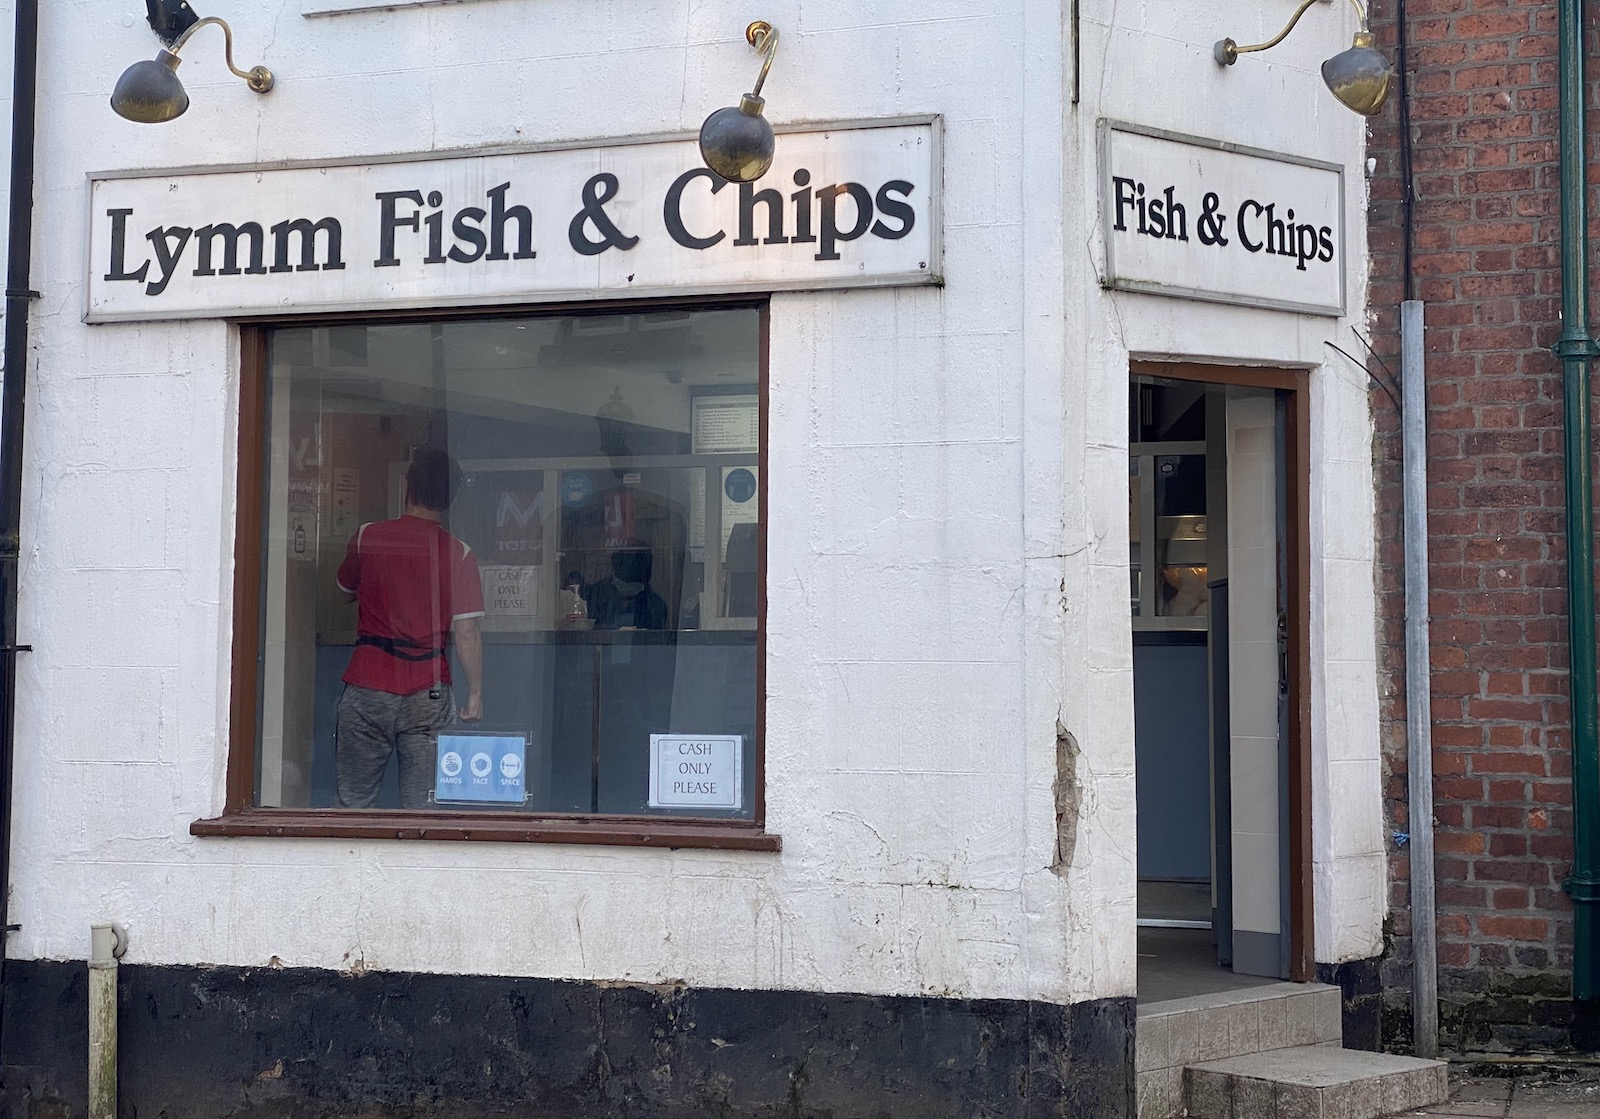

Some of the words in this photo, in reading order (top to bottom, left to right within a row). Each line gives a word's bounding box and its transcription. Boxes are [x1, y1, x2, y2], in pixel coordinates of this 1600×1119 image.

[1112, 176, 1189, 243] Fish
[1197, 191, 1229, 247] &
[1237, 199, 1335, 271] Chips
[104, 207, 347, 296] Lymm
[374, 181, 537, 268] Fish
[568, 172, 640, 257] &
[663, 167, 916, 261] Chips
[498, 571, 522, 581] CASH
[498, 585, 522, 595] ONLY
[494, 599, 526, 609] PLEASE
[678, 743, 712, 755] CASH
[678, 762, 712, 774] ONLY
[440, 777, 463, 785] HANDS
[501, 778, 521, 786] SPACE
[673, 781, 717, 794] PLEASE
